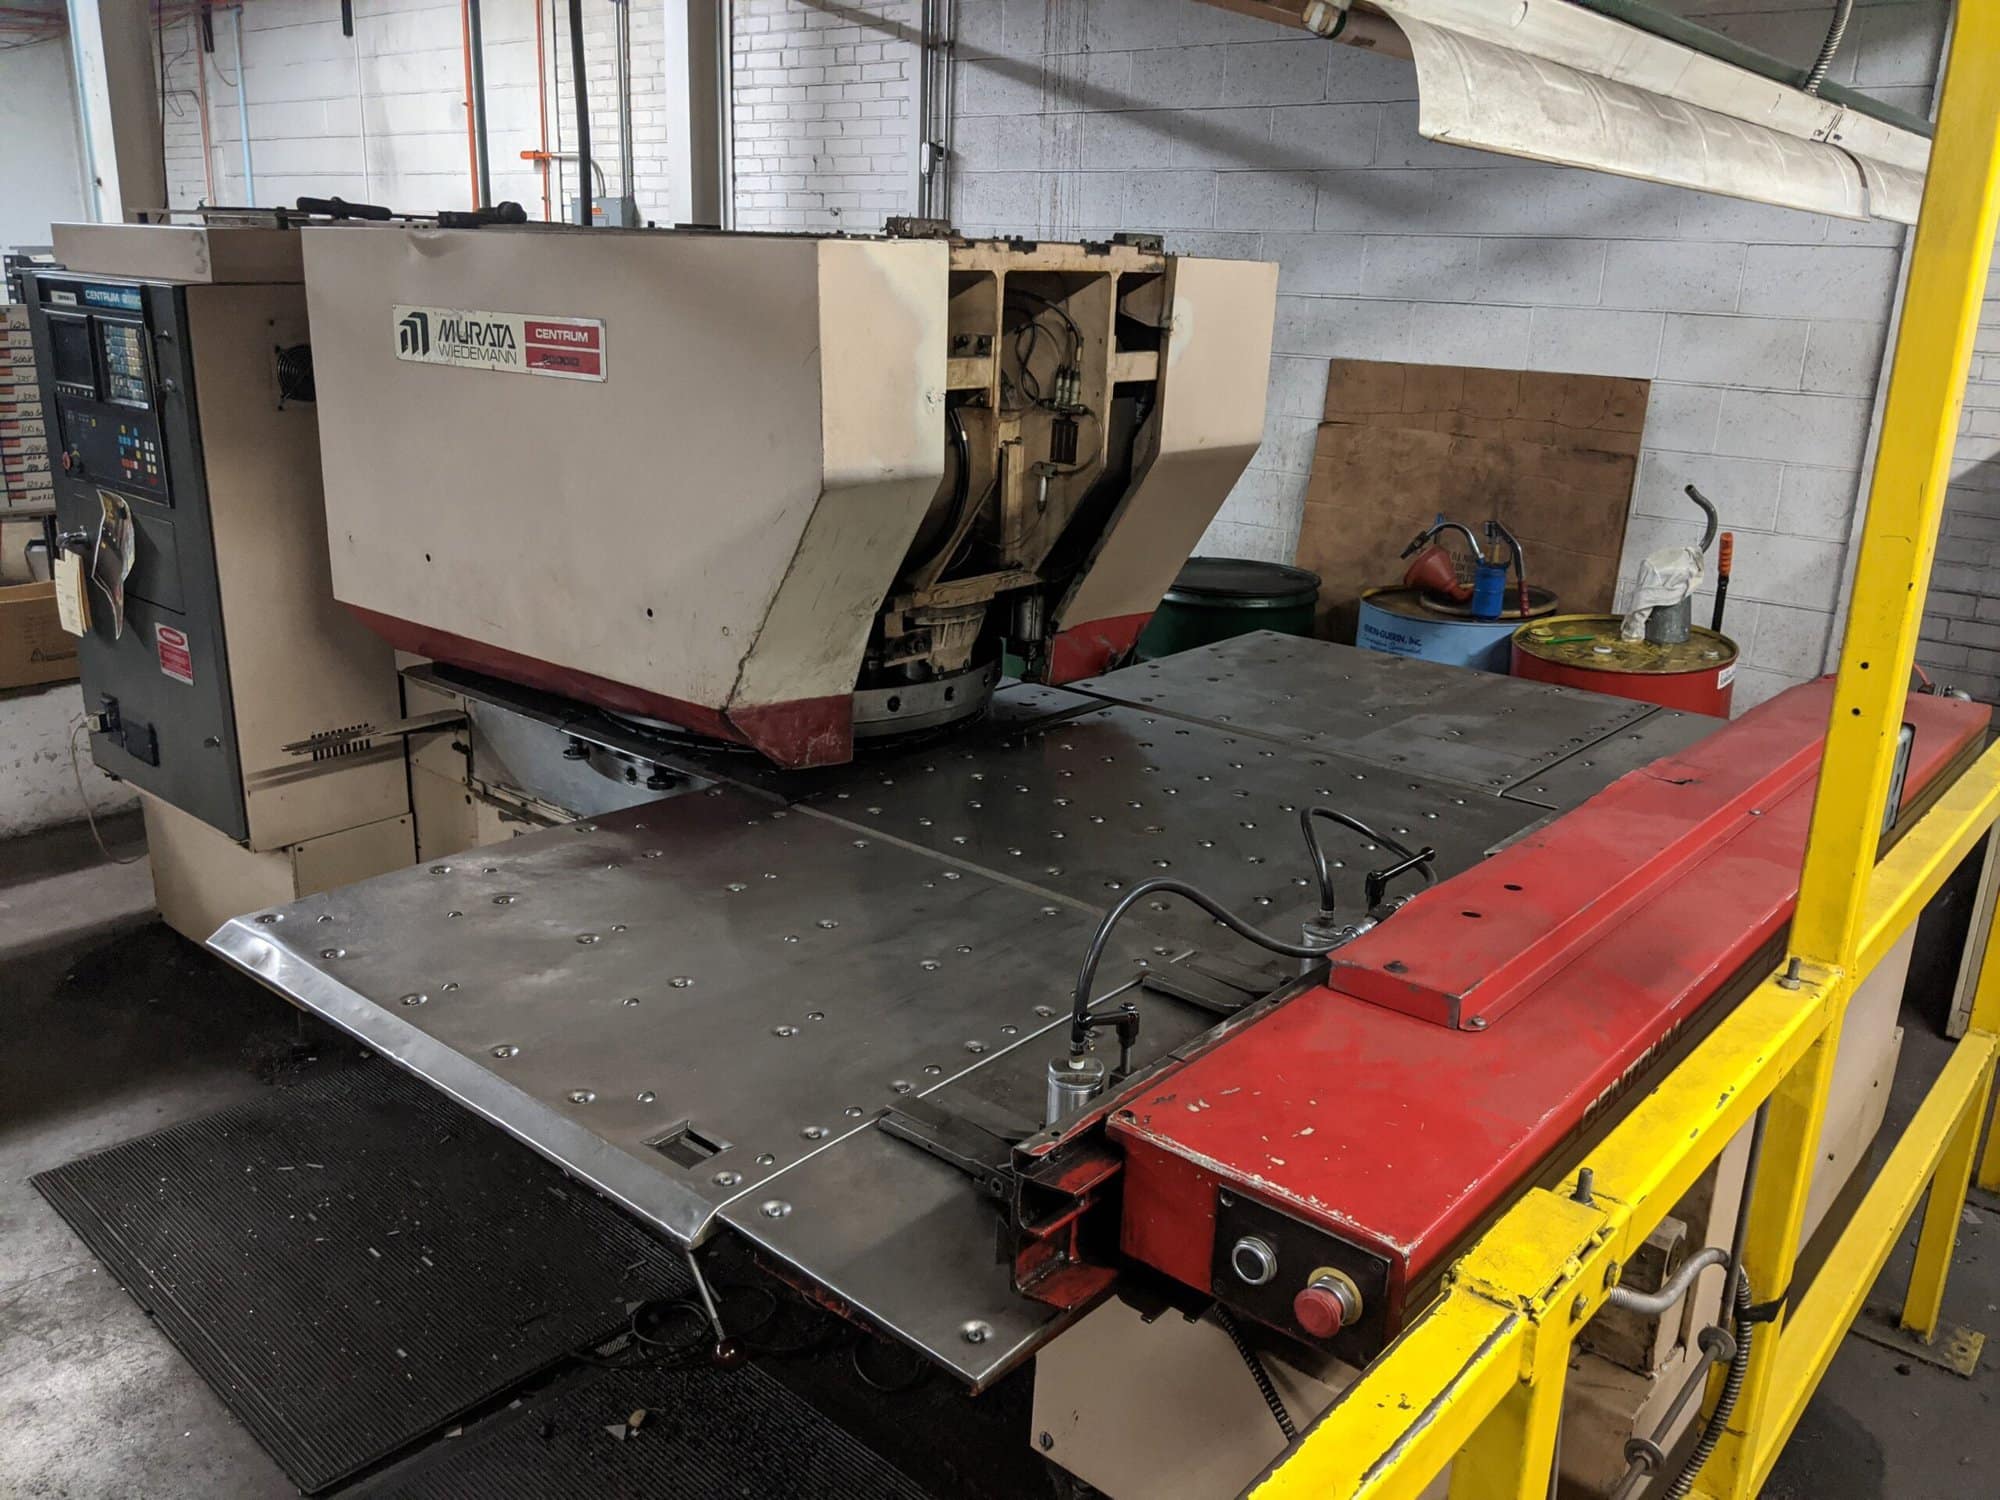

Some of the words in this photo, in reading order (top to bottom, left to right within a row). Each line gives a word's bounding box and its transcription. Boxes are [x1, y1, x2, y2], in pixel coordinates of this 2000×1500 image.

[85, 290, 119, 303] CENTRUM
[438, 319, 516, 349] MURATA
[535, 328, 588, 343] CENTRUM
[438, 342, 517, 365] WIEDEMANN
